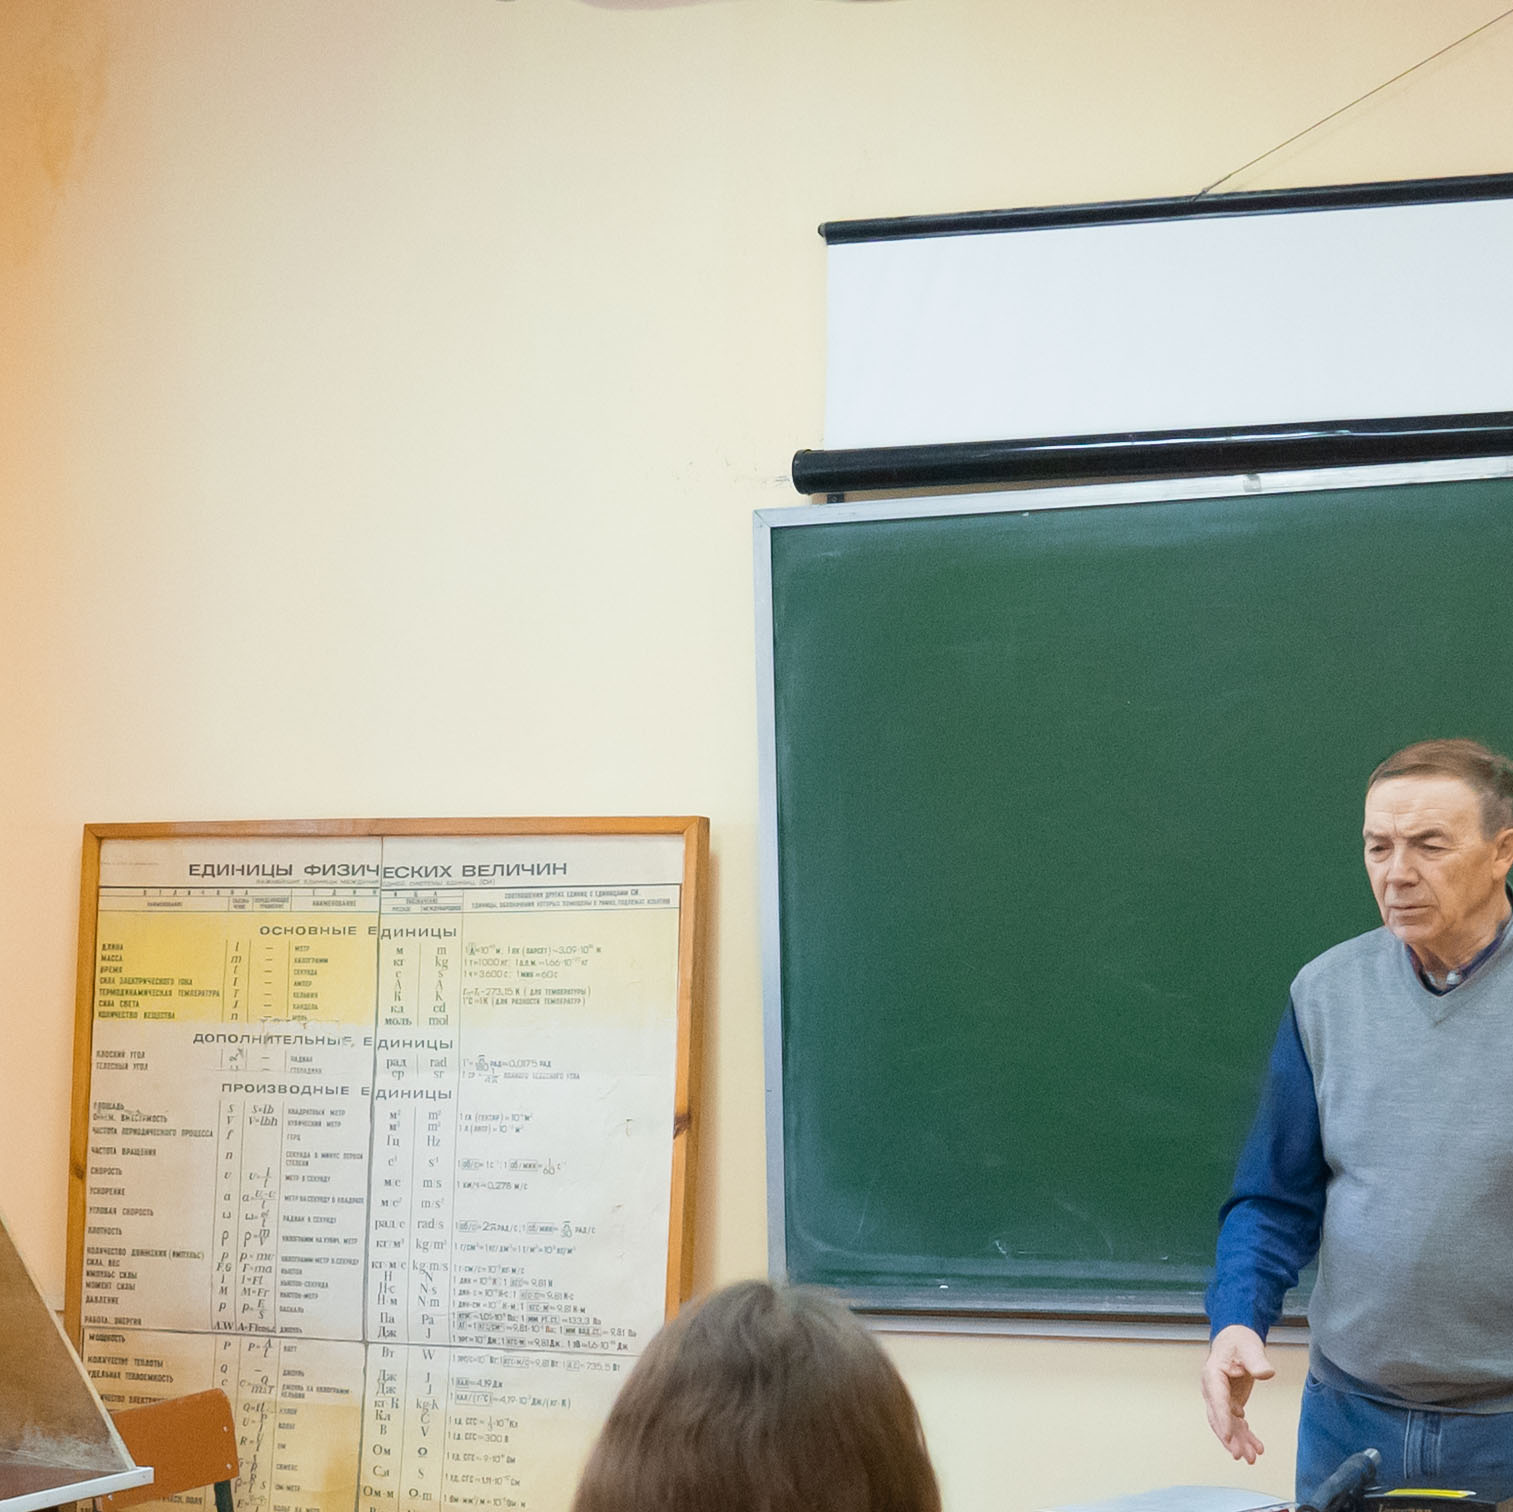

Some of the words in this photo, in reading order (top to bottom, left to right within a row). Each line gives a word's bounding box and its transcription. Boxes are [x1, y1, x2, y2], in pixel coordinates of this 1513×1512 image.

[189, 864, 293, 878] ЕДИНИЦЫ
[303, 863, 452, 879] ФИЗИЧЕСКИХ
[462, 863, 567, 877] ВЕЛИЧИН
[260, 926, 357, 936] ОСНОВНЫЕ
[435, 956, 448, 970] kg
[364, 1036, 454, 1050] ЕДИНИЦЫ
[430, 1057, 447, 1067] rad
[222, 1083, 350, 1095] ПРОИЗВОДНЫЕ
[361, 1087, 452, 1101] ЕДИНИЦЫ
[380, 1311, 395, 1324] Па
[377, 1369, 397, 1382] Дж
[376, 1383, 397, 1396] Дж
